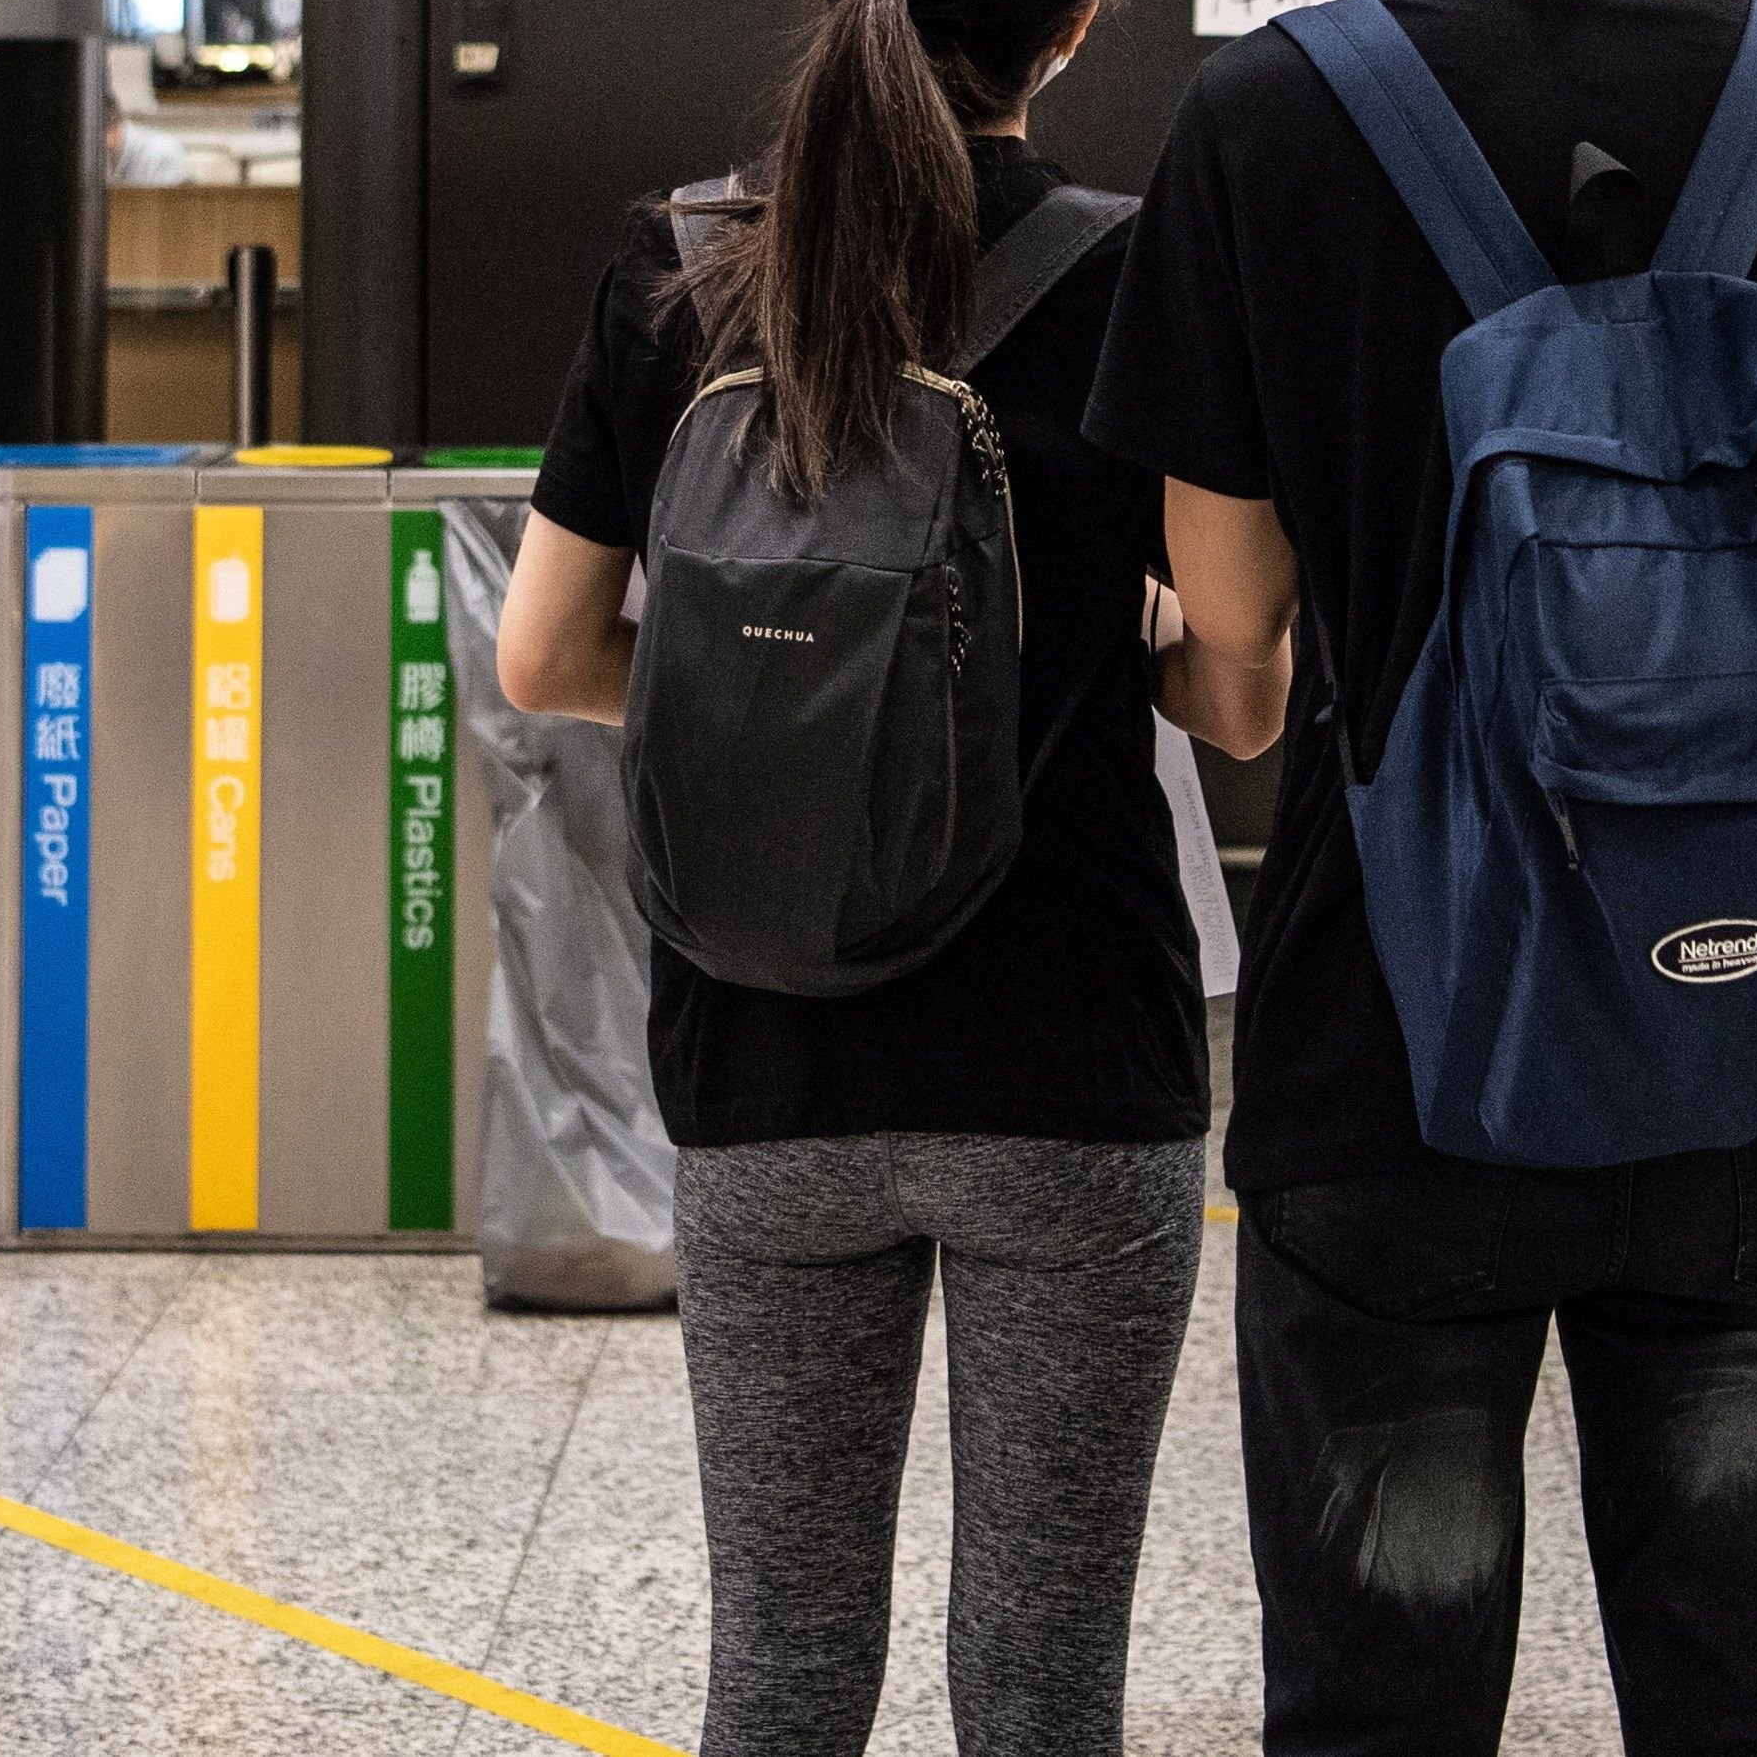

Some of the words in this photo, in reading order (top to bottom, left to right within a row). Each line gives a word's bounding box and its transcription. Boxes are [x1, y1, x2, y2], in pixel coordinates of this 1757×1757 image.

[742, 624, 816, 644] QUECHUA
[35, 773, 78, 908] Paper
[207, 774, 246, 883] Cans
[402, 775, 443, 950] Plastics
